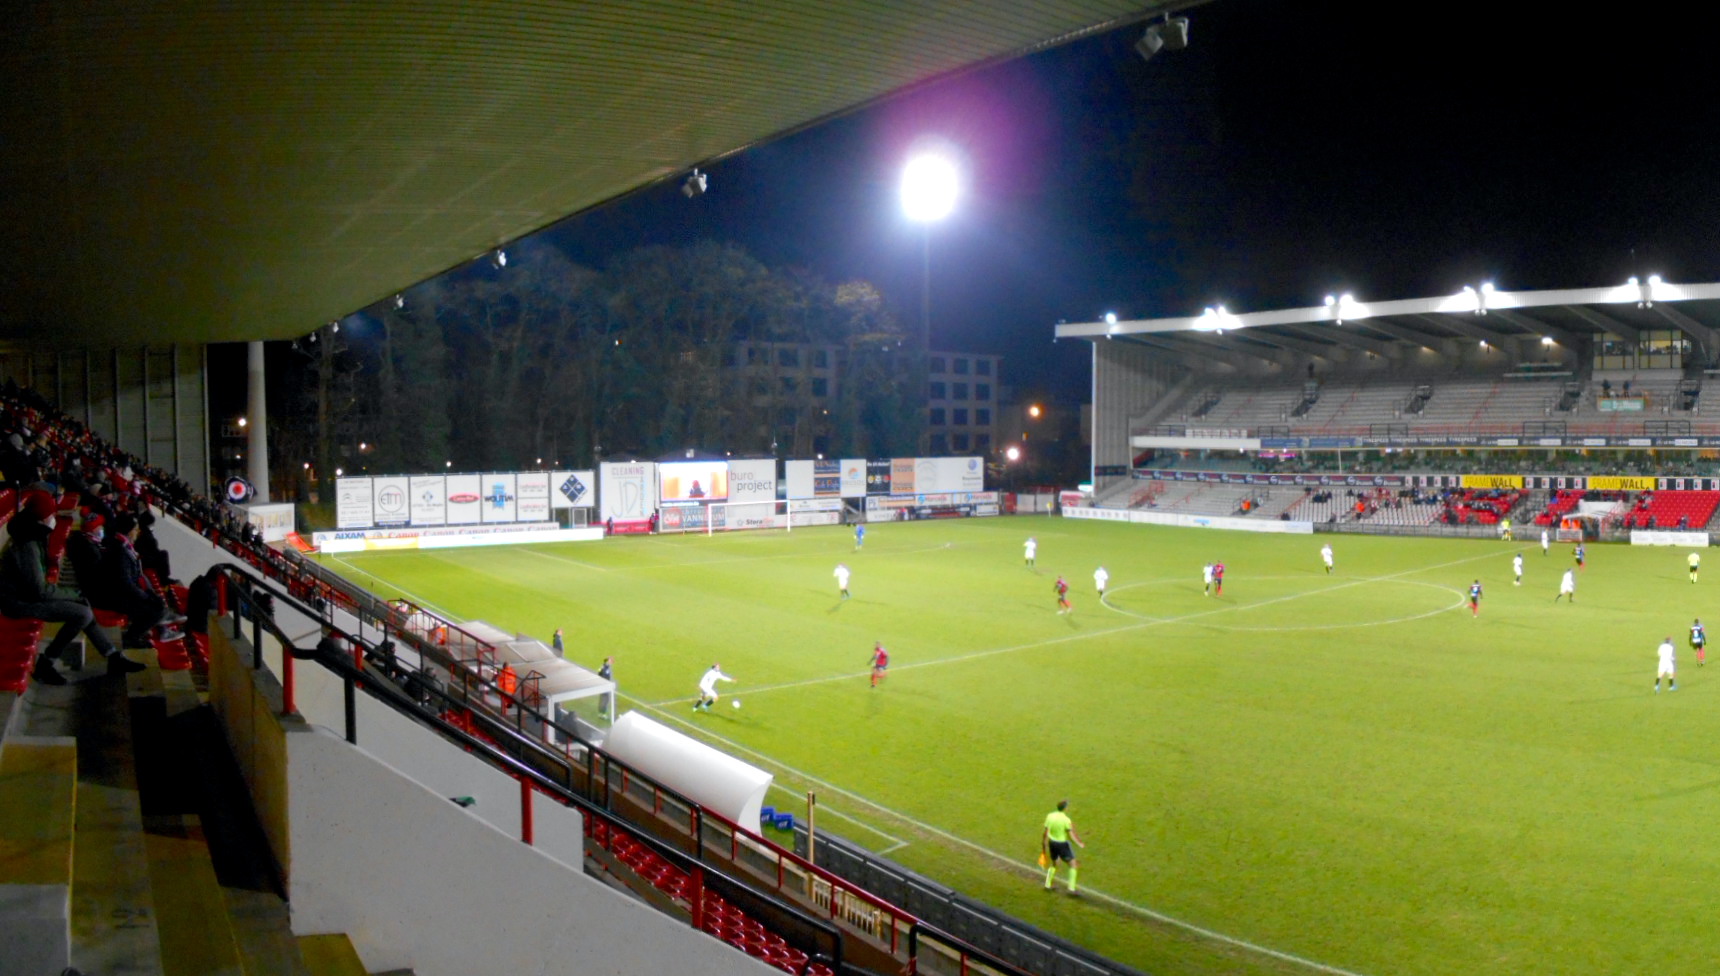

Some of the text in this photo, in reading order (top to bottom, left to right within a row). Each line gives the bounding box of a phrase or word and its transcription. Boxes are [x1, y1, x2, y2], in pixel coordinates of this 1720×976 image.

[611, 466, 644, 475] CLEANING
[731, 472, 753, 480] buro
[737, 480, 772, 491] project
[334, 532, 365, 540] AIXAM
